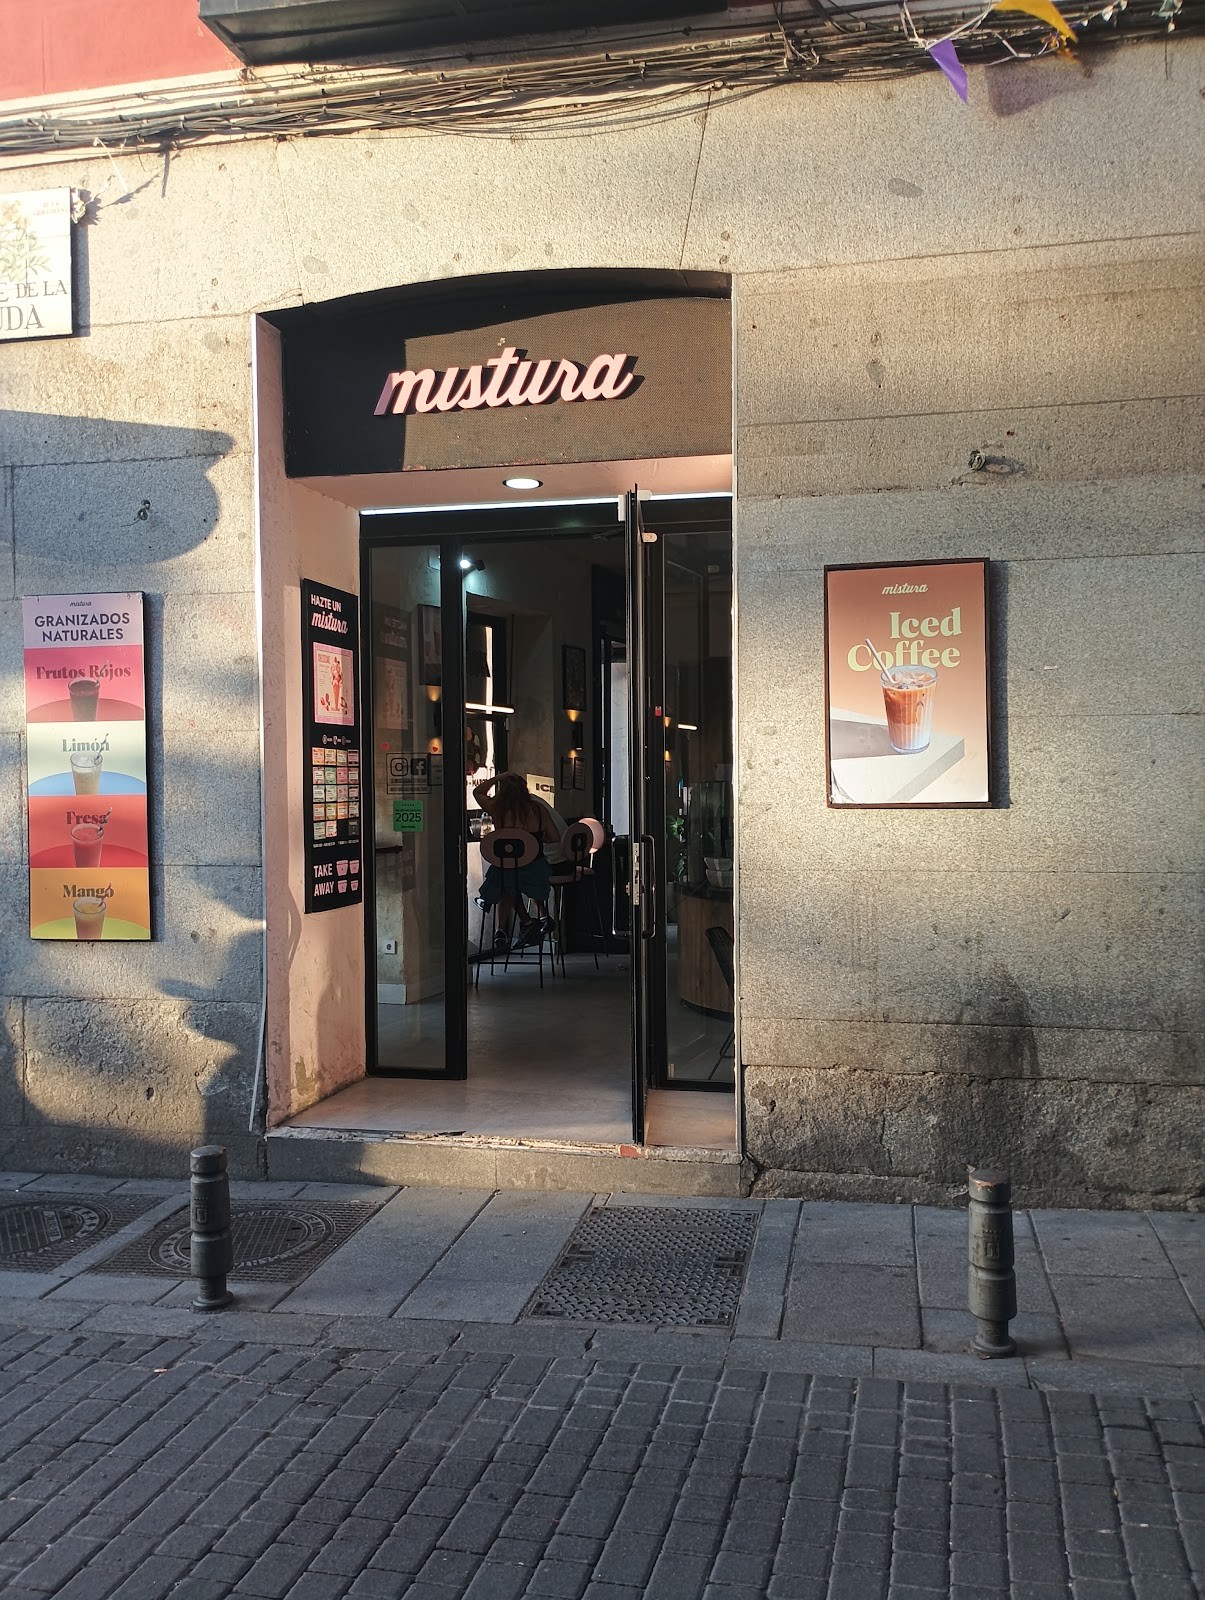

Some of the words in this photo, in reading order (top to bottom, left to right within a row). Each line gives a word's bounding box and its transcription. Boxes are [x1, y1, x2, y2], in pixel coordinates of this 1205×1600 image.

[14, 282, 39, 299] DE
[43, 279, 68, 297] LA
[373, 346, 635, 416] mistura
[881, 582, 929, 595] mistura
[310, 593, 332, 610] HAZTE
[332, 600, 342, 613] UN
[34, 612, 130, 628] GRANIZADOS
[311, 610, 349, 634] mistura
[889, 607, 963, 639] Iced
[42, 628, 124, 643] NATURALES
[847, 639, 961, 672] Coffee
[36, 666, 86, 680] Frutos
[89, 663, 131, 681] Rojos
[62, 737, 110, 752] Limón
[66, 811, 108, 825] Fresa
[395, 812, 422, 823] 2025
[313, 863, 333, 878] TAKE
[63, 884, 115, 898] Mango
[313, 881, 335, 897] AWAY
